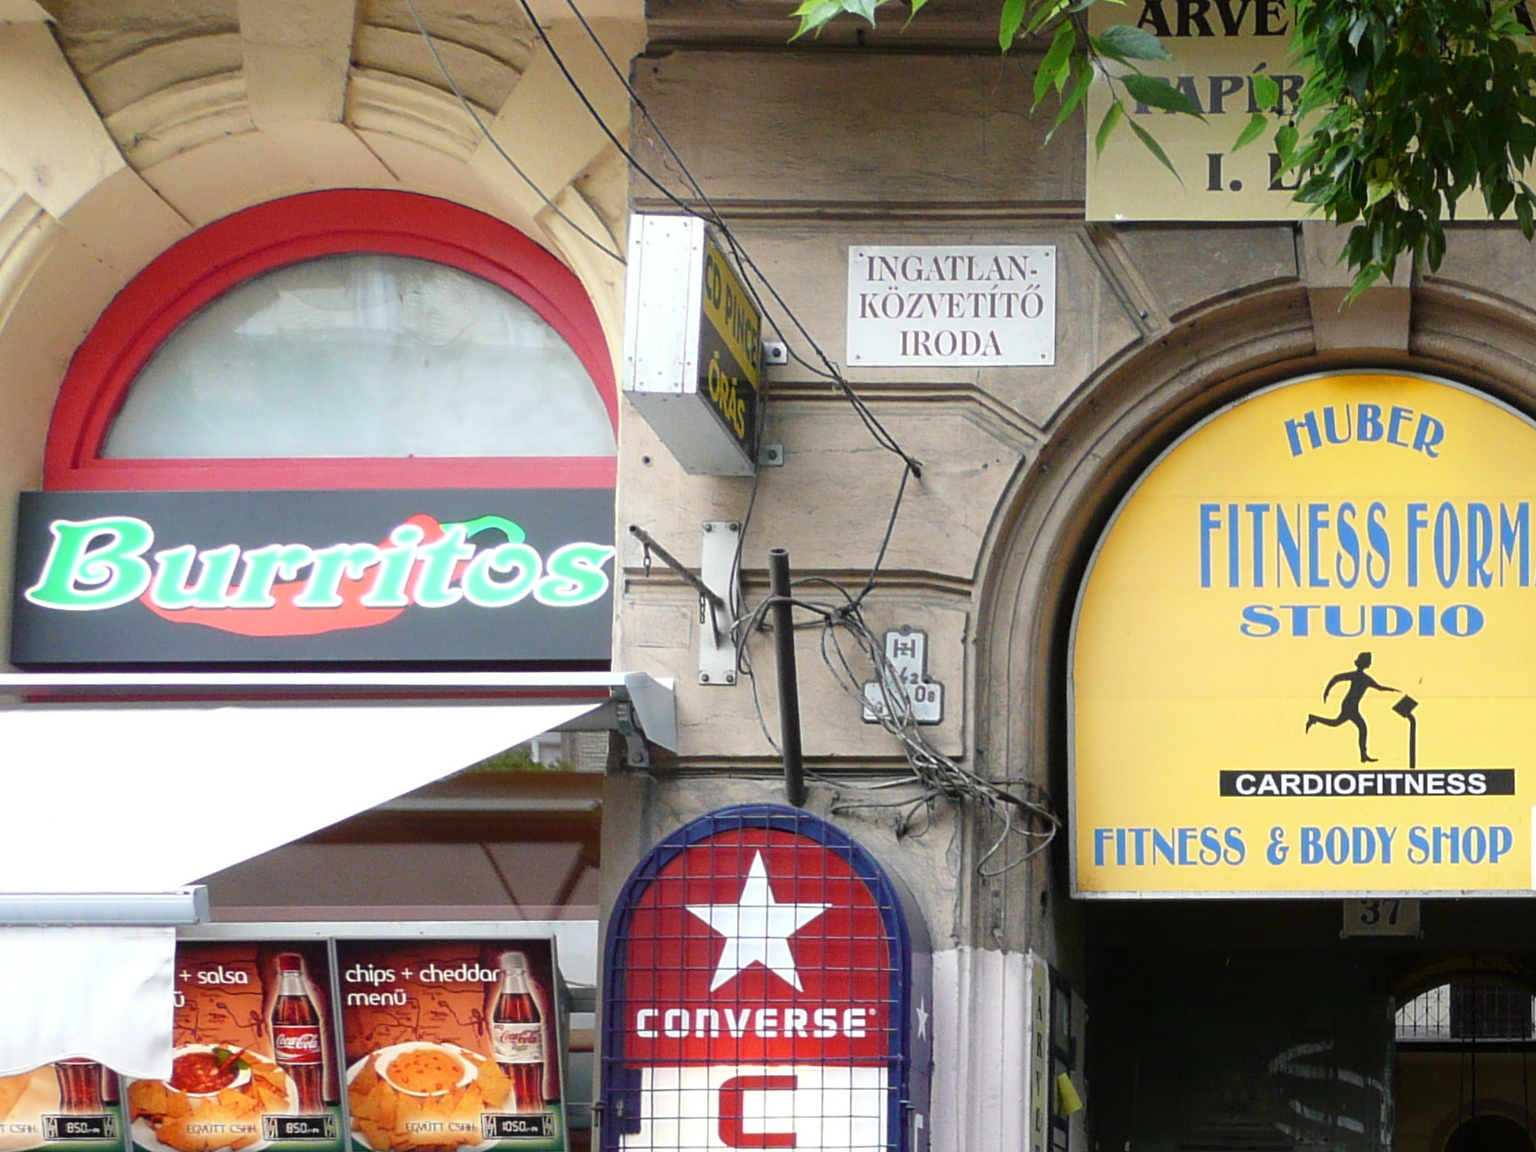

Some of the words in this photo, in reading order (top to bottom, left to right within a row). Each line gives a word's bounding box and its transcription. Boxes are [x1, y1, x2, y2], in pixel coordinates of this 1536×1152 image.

[866, 255, 1038, 282] INGATLAN-
[859, 284, 1044, 319] KÖZVETÍTŐ
[900, 330, 1003, 357] IRODA
[1284, 404, 1445, 458] HUBER
[1199, 500, 1391, 589] FITNESS
[24, 515, 616, 612] Burritos
[1240, 603, 1485, 638] STUDIO
[1234, 772, 1488, 796] CARDIOFITNESS
[1094, 826, 1246, 868] FITNESS
[1267, 829, 1290, 866] &
[1300, 826, 1396, 867] BODY
[1408, 825, 1514, 867] SHOP
[1360, 899, 1400, 925] 37
[197, 965, 249, 985] salsa
[345, 964, 396, 987] chips
[419, 964, 501, 983] cheddar
[347, 988, 407, 1006] menü
[636, 1008, 866, 1038] CONVERSE
